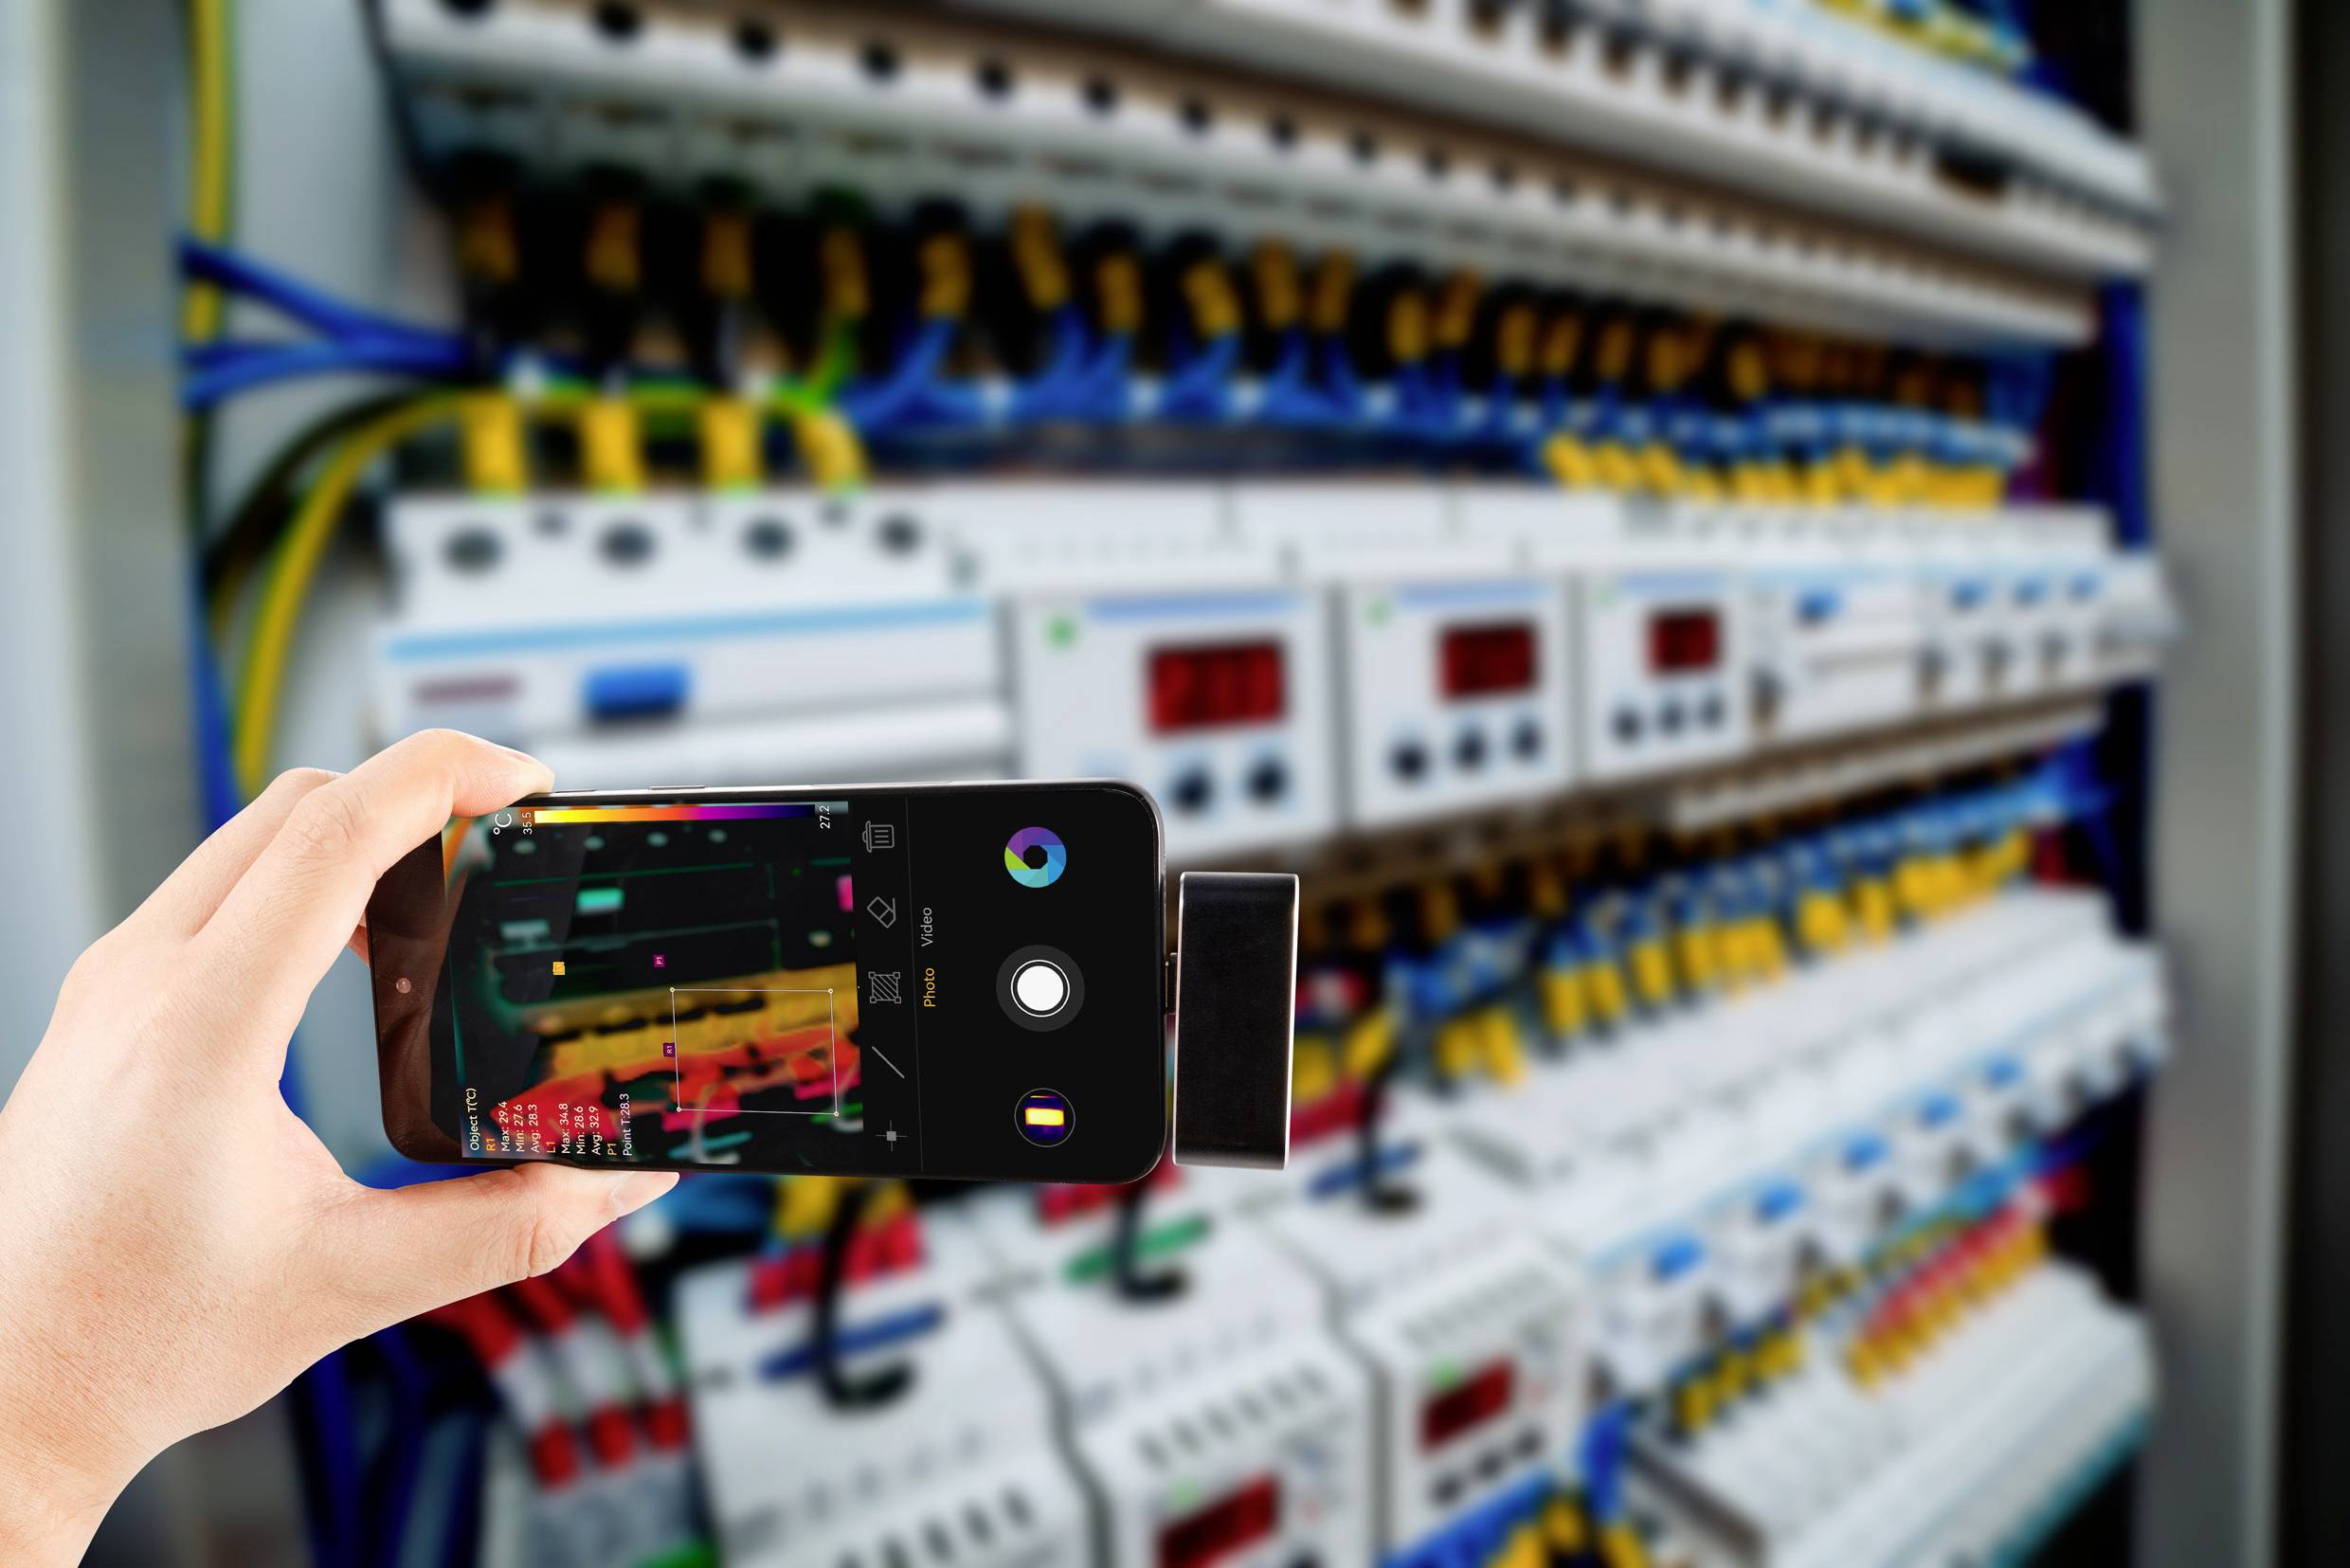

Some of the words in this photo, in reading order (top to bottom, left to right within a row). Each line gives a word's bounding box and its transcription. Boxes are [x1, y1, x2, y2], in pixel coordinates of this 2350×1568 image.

[521, 812, 533, 835] 35.5
[819, 805, 831, 829] 27.2
[920, 907, 933, 947] Video
[923, 967, 936, 1007] Photo
[497, 1101, 509, 1124] 29.4
[513, 1104, 524, 1126] 27.6
[528, 1104, 538, 1126] 28.3
[558, 1103, 569, 1126] 34.8
[573, 1106, 585, 1128] 28.6
[588, 1106, 600, 1128] 32.9
[619, 1092, 631, 1126] T:28.3
[469, 1115, 481, 1151] Object
[484, 1137, 496, 1151] R1
[500, 1127, 511, 1152] Max:
[515, 1130, 525, 1152] Min:
[530, 1129, 541, 1153] Avg:
[560, 1128, 570, 1154] Max:
[575, 1131, 586, 1155] Min:
[590, 1131, 603, 1156] Avg:
[622, 1128, 633, 1156] Point
[546, 1141, 556, 1153] L1
[606, 1143, 618, 1156] P1
